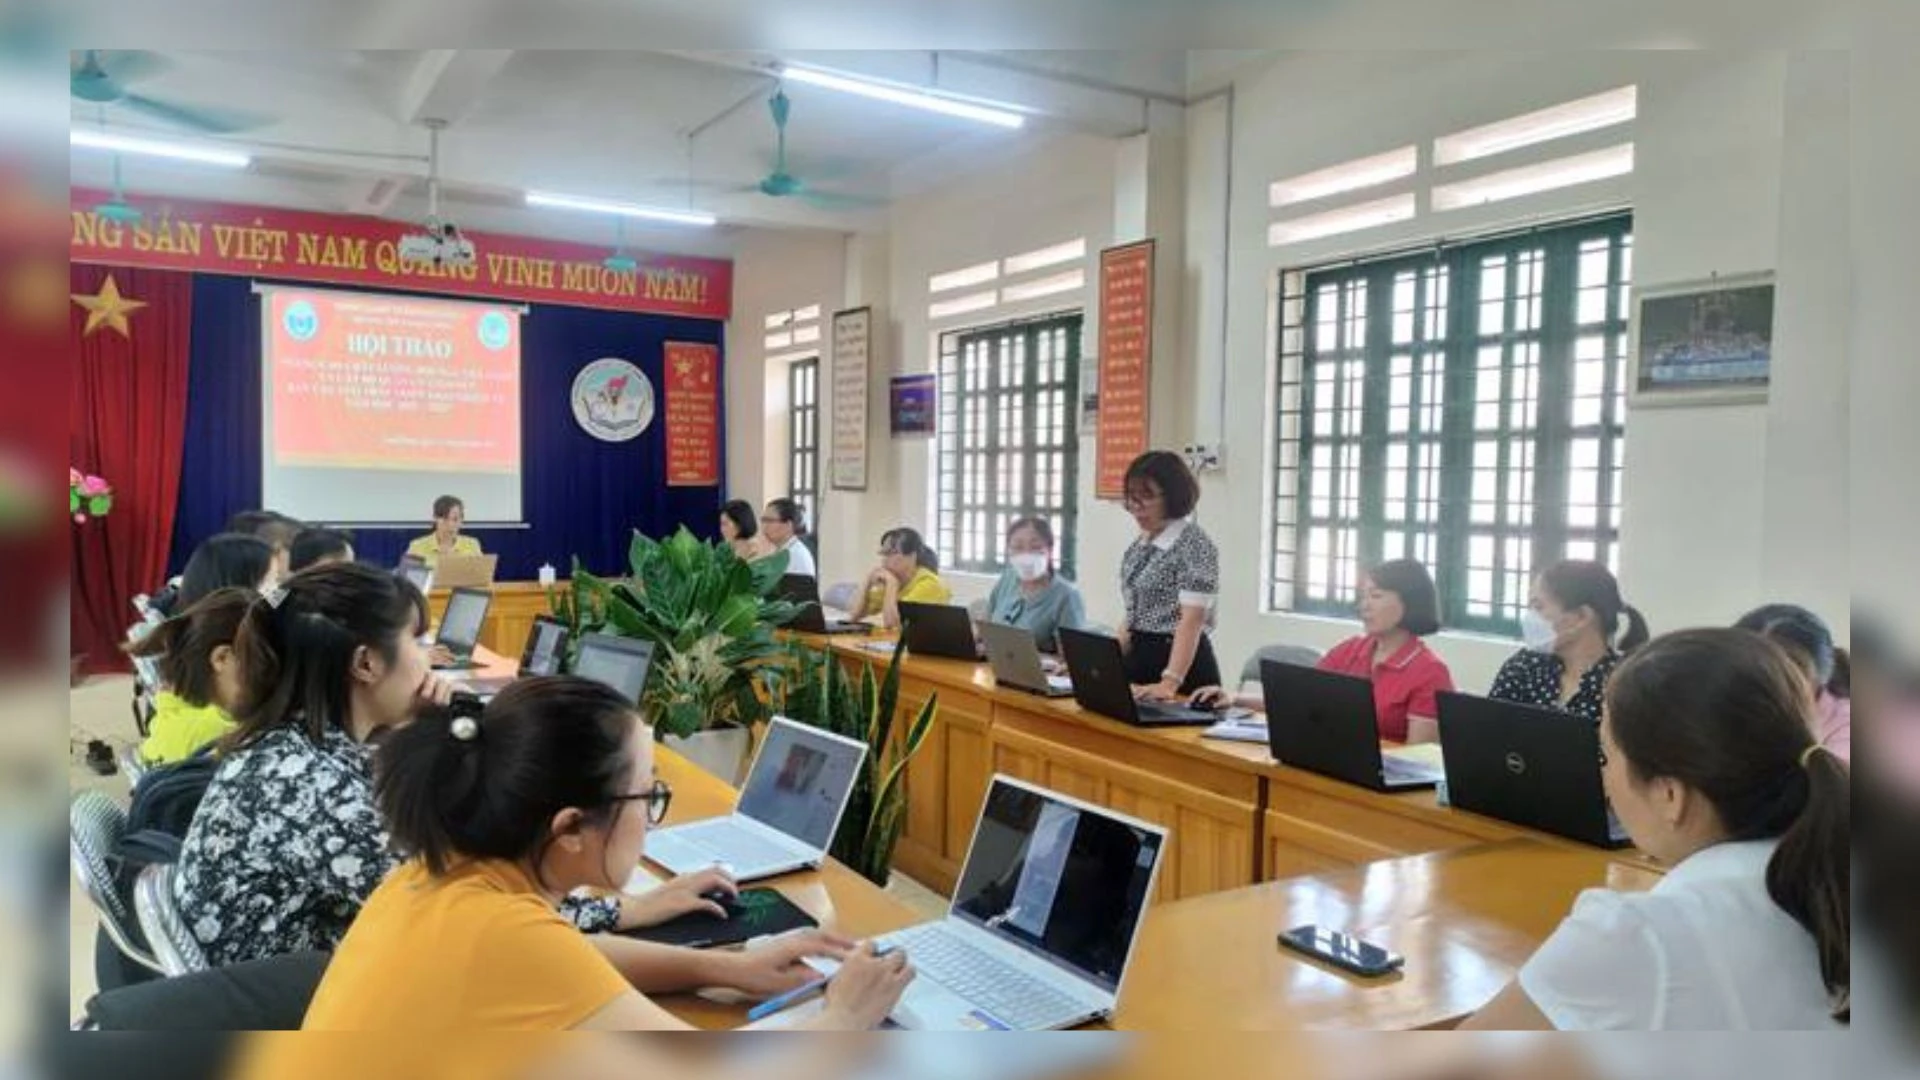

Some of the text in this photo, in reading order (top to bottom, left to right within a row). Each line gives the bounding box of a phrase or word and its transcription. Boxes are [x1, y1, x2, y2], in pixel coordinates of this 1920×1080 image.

[211, 217, 289, 269] VIỆT
[295, 233, 369, 271] NAM
[486, 253, 557, 291] VINH
